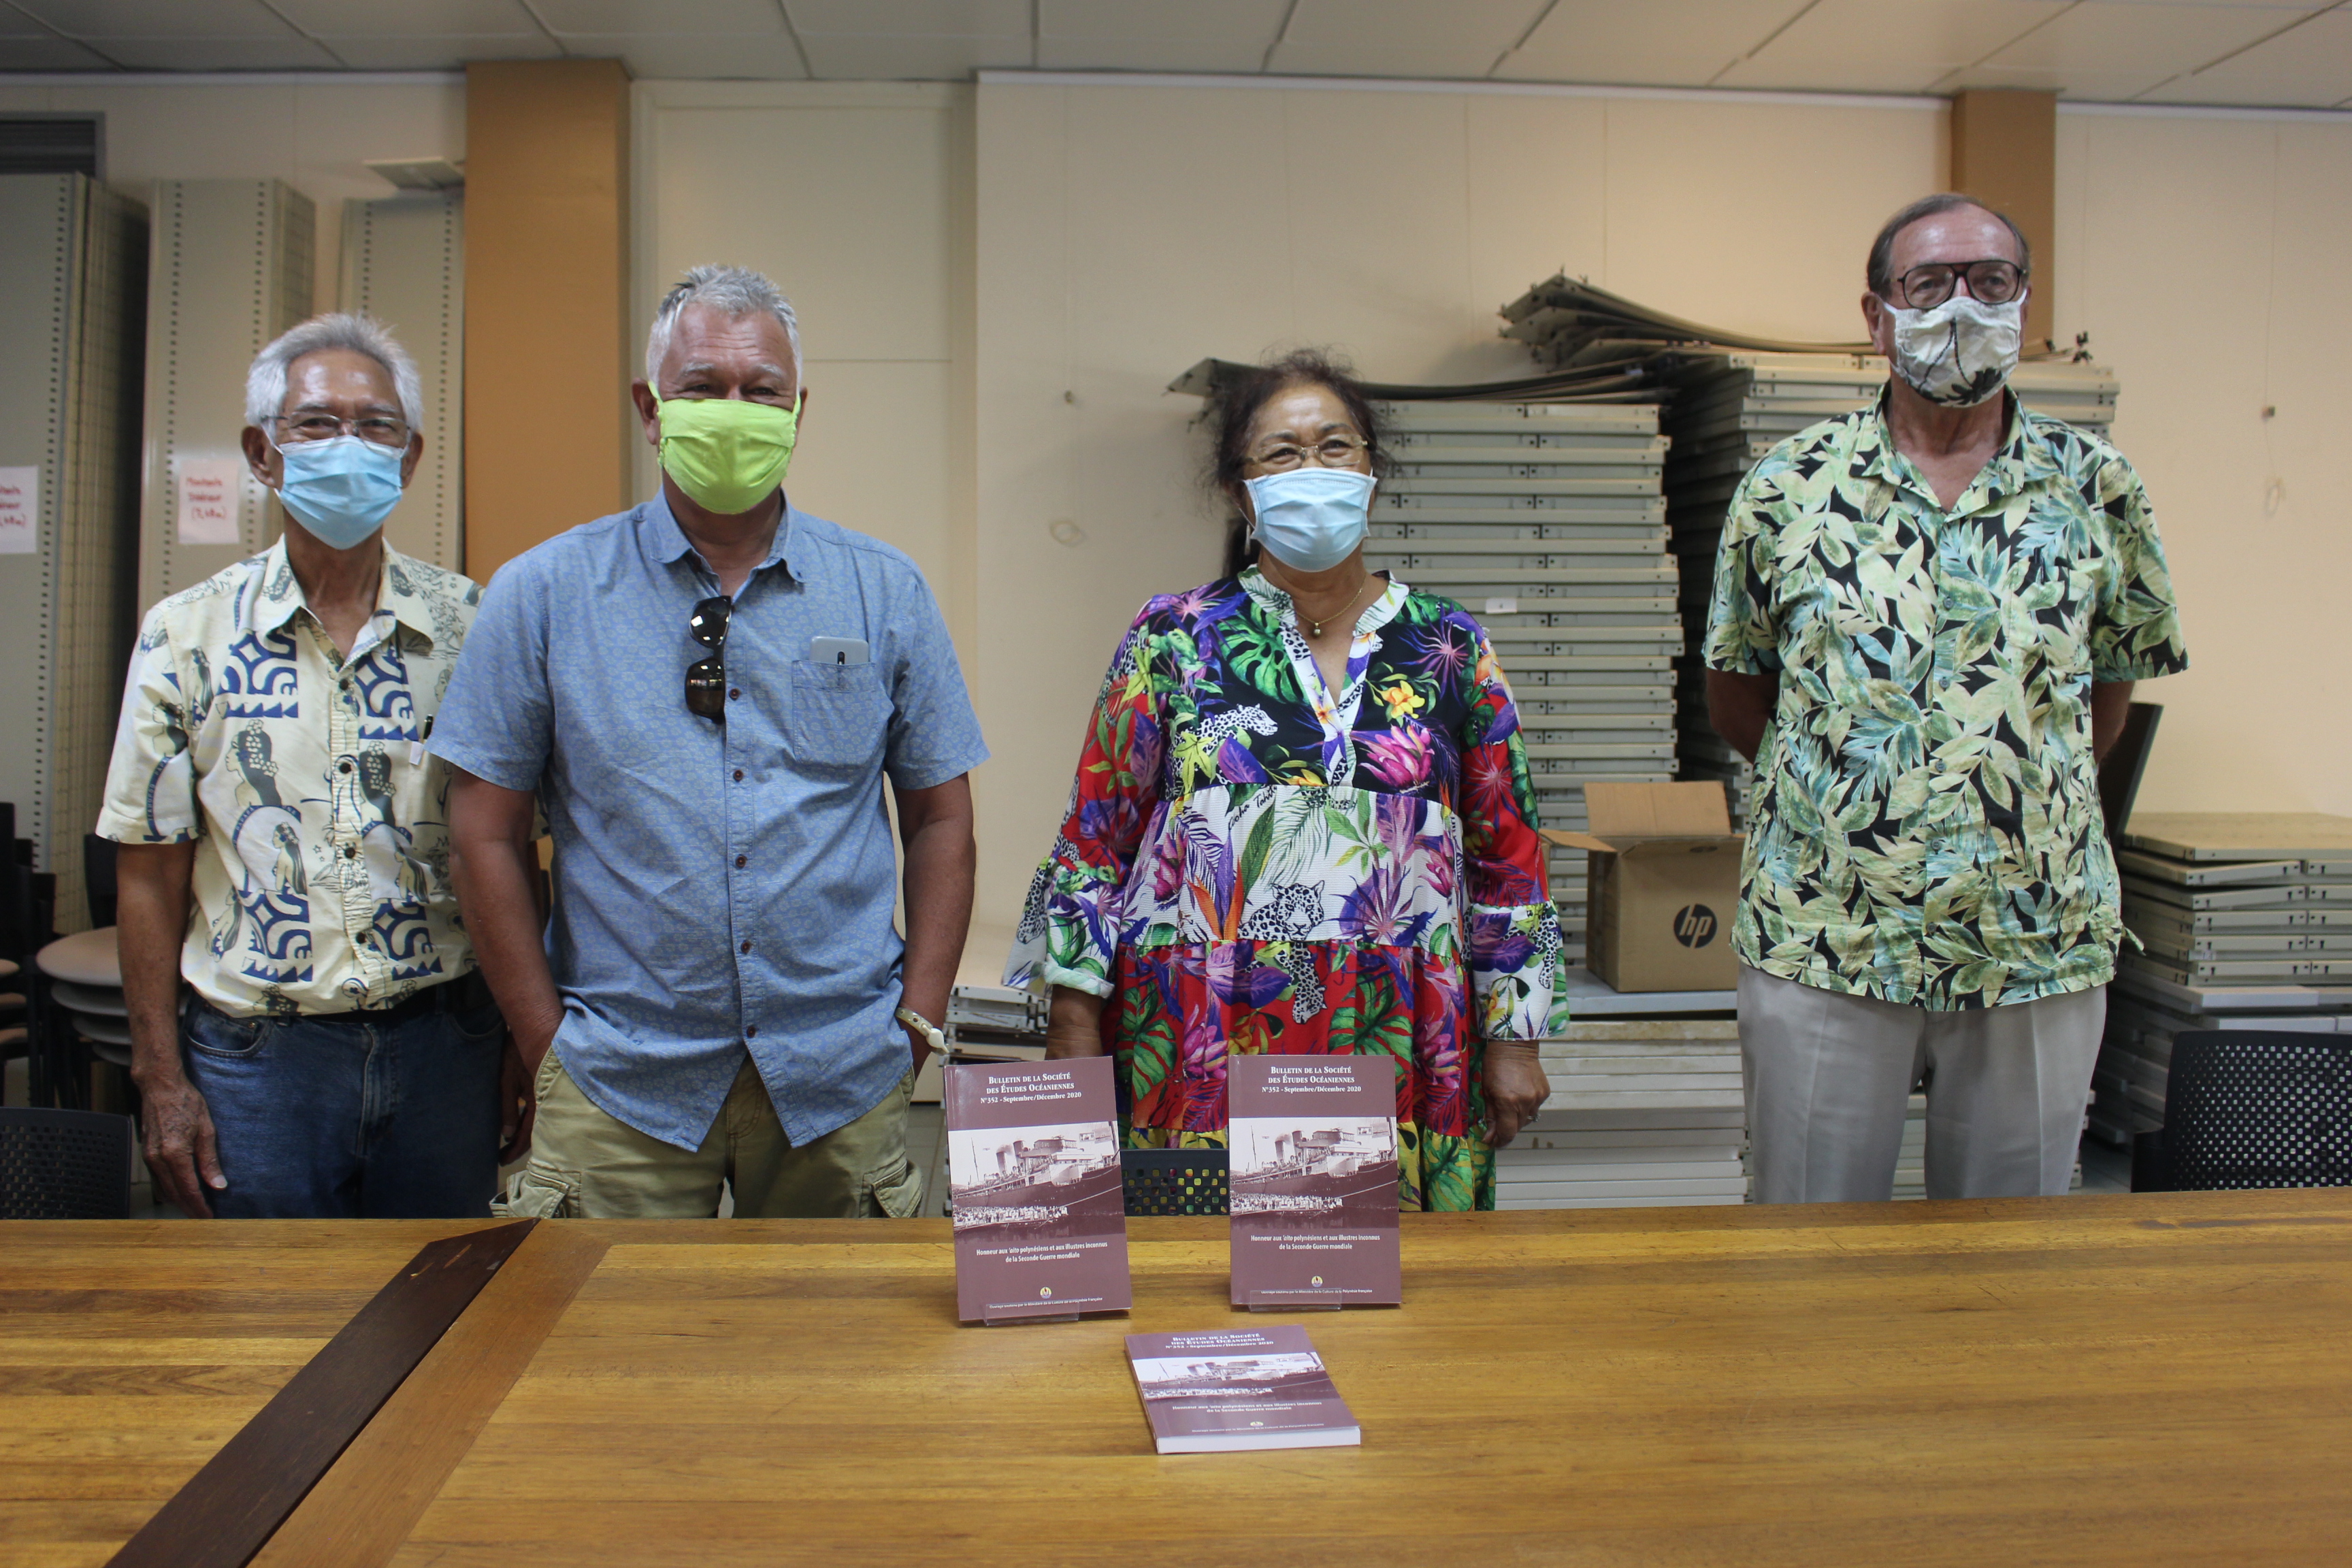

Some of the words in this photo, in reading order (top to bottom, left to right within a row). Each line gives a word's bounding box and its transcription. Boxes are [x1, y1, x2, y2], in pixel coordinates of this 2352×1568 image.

[1679, 903, 1713, 949] hp
[1043, 1072, 1071, 1081] SOCIÉTÉ
[1283, 1074, 1308, 1083] ÉTUDES
[1310, 1074, 1354, 1083] OCÉANIENNES
[1001, 1083, 1026, 1093] ÉTUDES
[1029, 1083, 1074, 1092] OCÉANIENNES
[1284, 1085, 1345, 1094] Septembre/Décembre
[1003, 1093, 1065, 1103] Septembre/Décembre
[1019, 1254, 1039, 1262] Seconde
